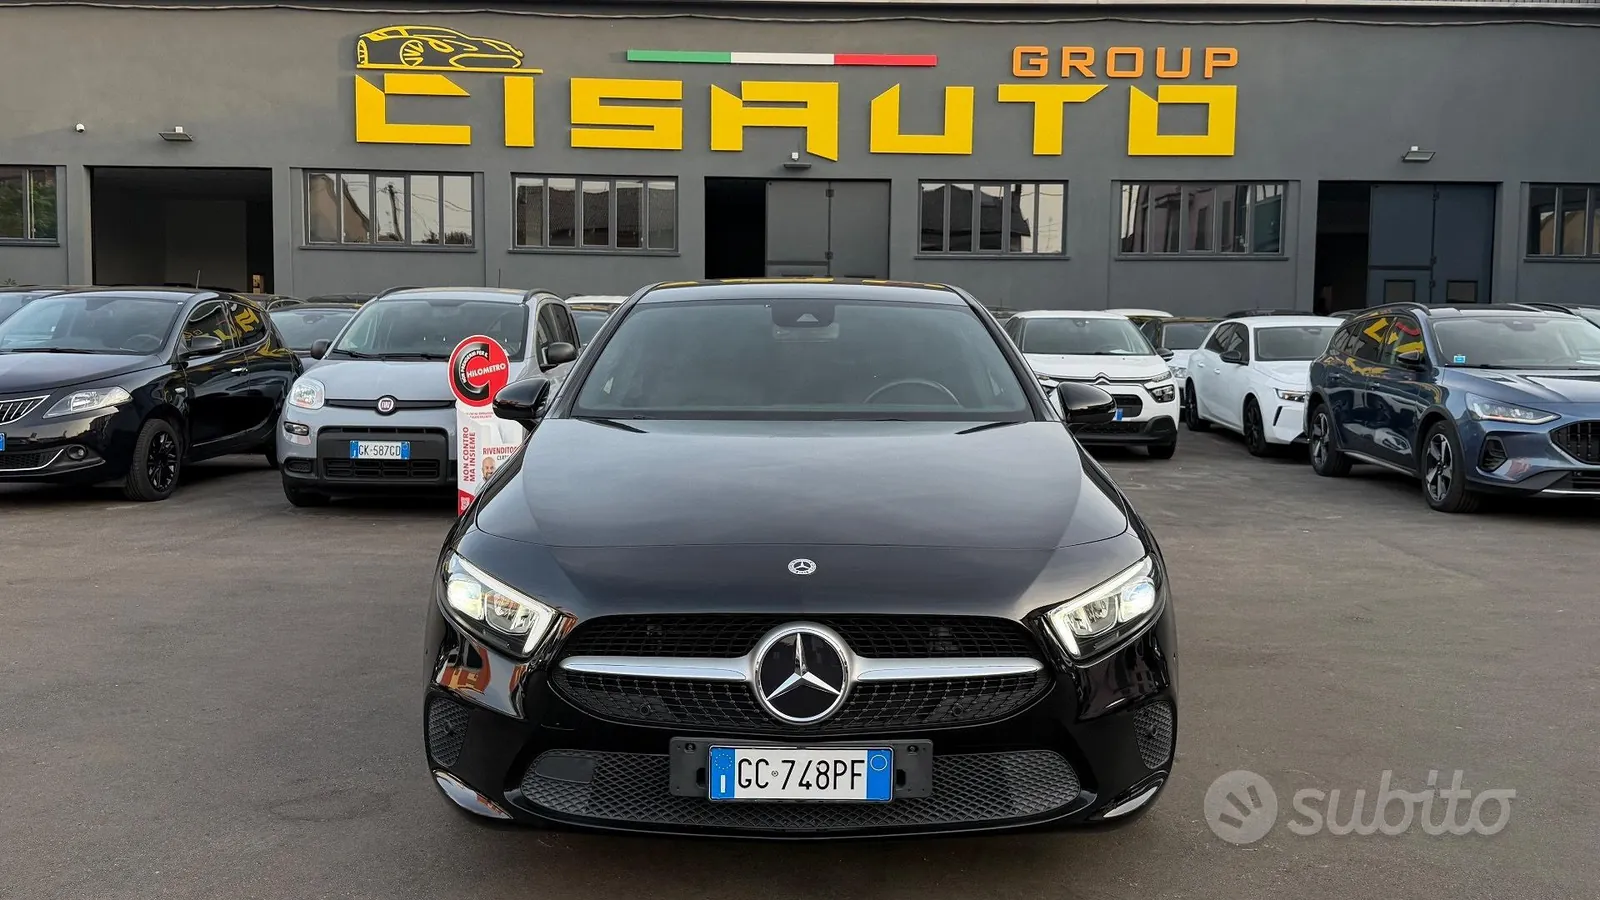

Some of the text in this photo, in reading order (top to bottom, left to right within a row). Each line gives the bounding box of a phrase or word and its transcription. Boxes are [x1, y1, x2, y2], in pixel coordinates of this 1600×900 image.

[1012, 45, 1239, 79] GROUP
[355, 73, 1238, 161] CISAUTO
[462, 426, 470, 482] NON CONTRO
[469, 470, 476, 482] MA
